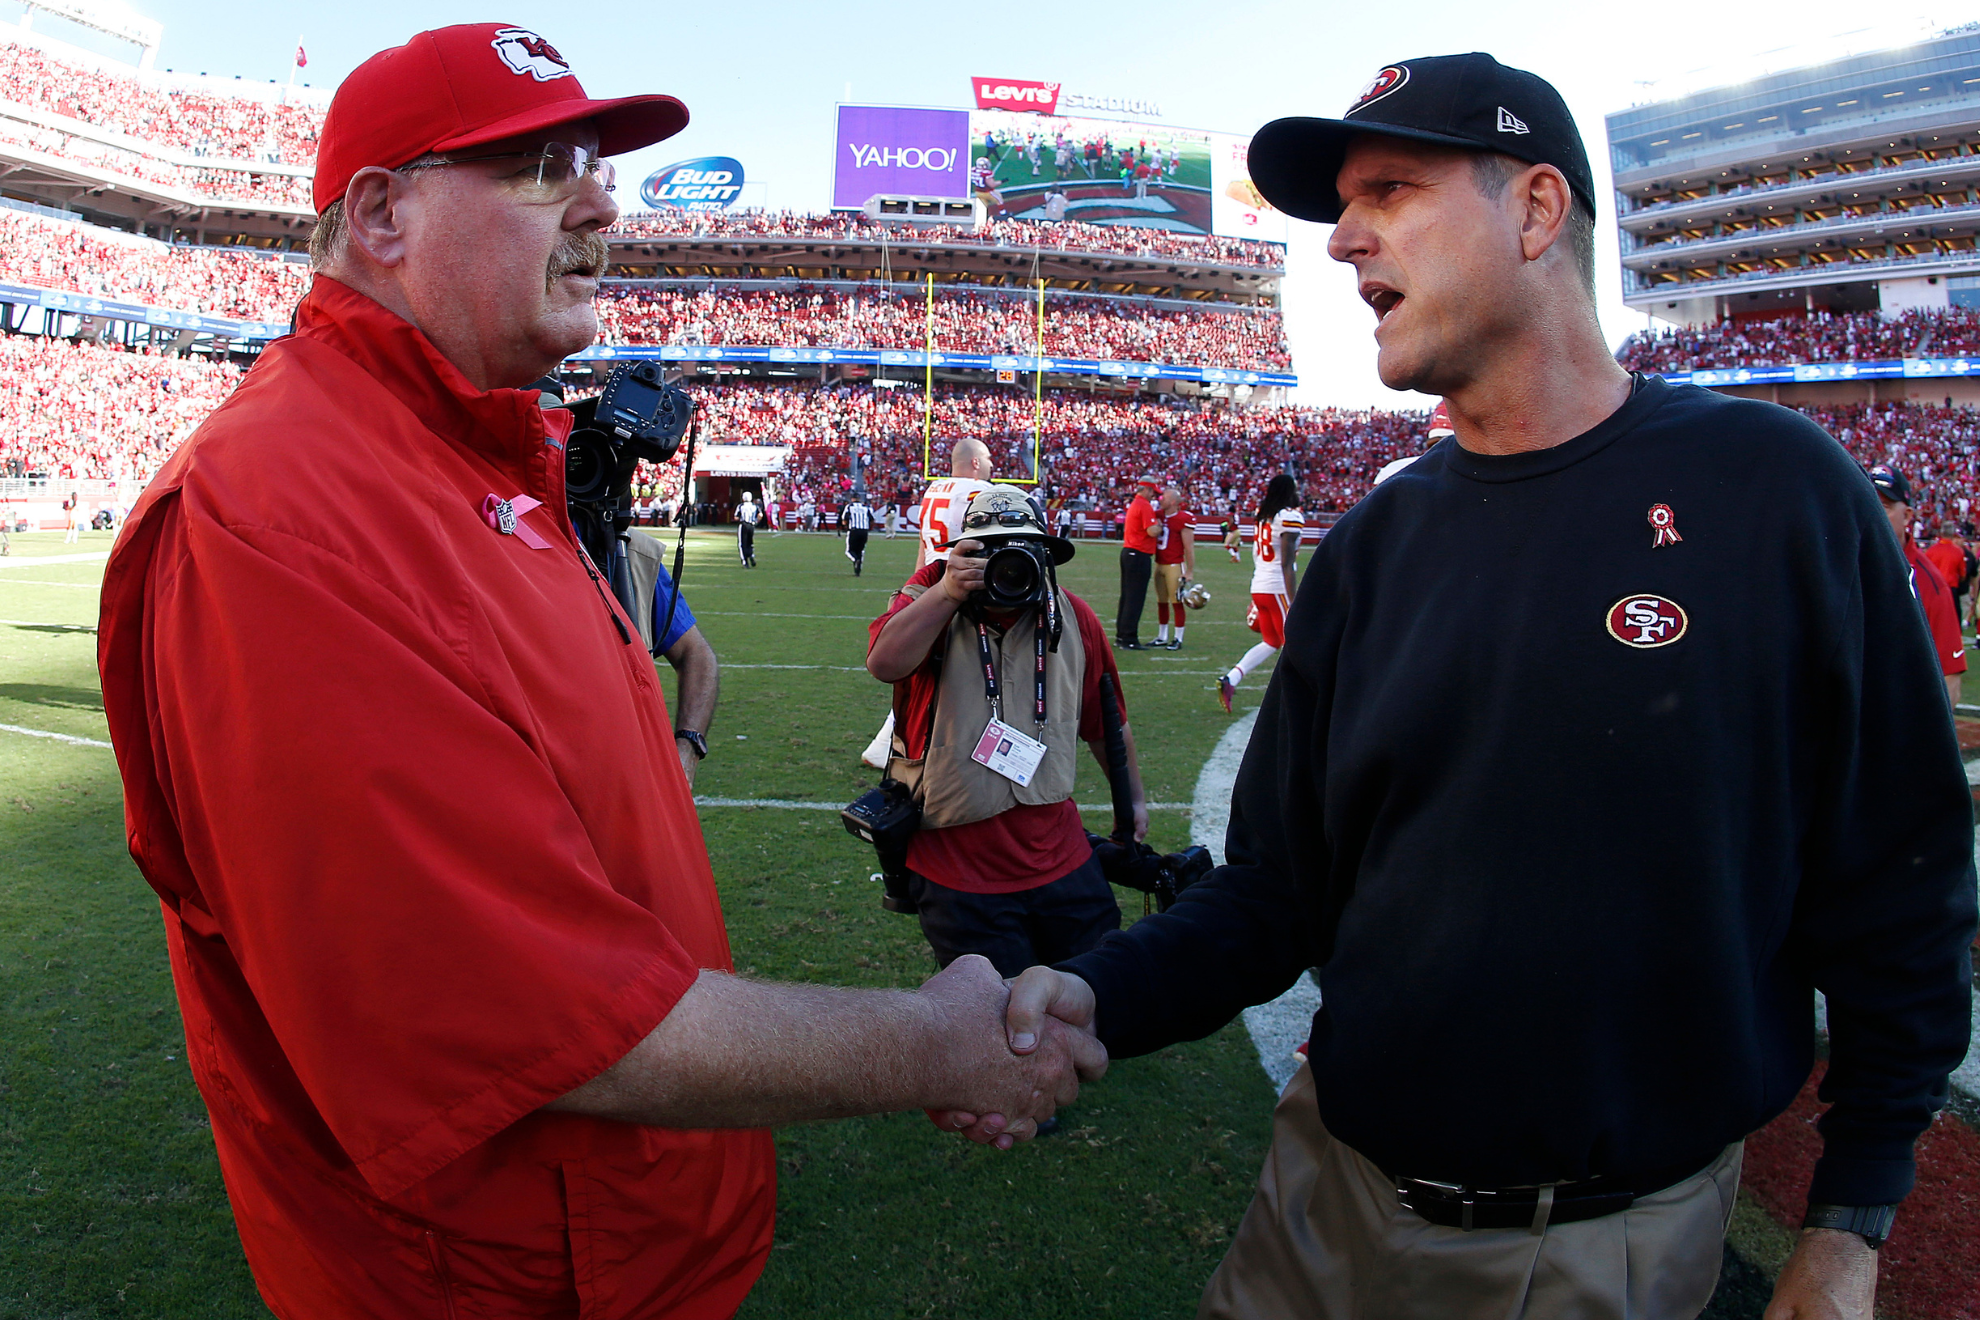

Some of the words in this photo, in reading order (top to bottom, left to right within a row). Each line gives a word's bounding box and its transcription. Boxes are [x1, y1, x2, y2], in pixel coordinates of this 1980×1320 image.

[514, 36, 569, 70] KC
[1066, 93, 1163, 117] STADIUM
[849, 143, 958, 173] YAHOO!
[999, 372, 1013, 382] 28
[919, 498, 951, 553] 75
[1624, 599, 1676, 643] SF
